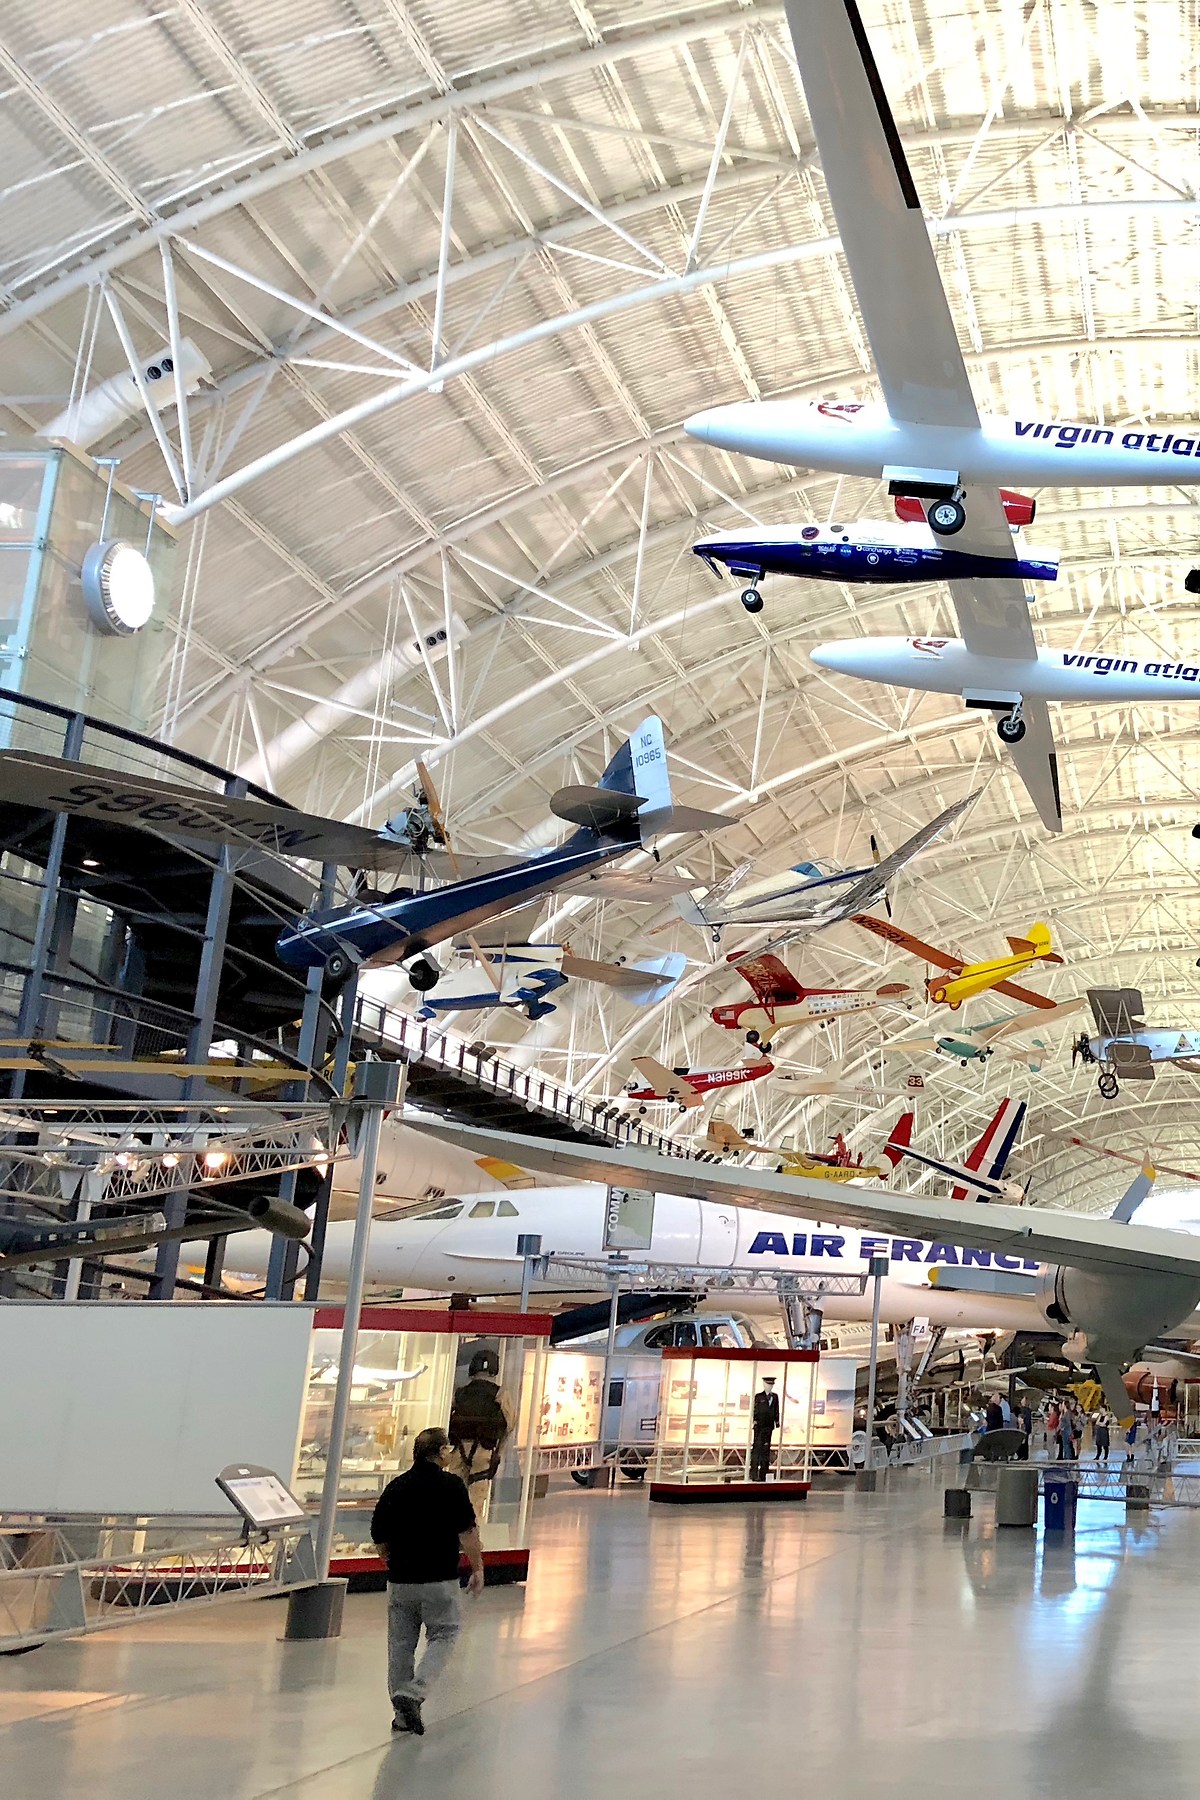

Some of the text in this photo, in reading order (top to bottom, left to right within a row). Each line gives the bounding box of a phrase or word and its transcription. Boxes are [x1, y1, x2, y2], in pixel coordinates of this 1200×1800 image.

[1014, 420, 1114, 449] virgin
[1063, 654, 1138, 676] virgin
[640, 733, 653, 748] NC
[635, 747, 661, 767] 10965
[909, 1076, 923, 1086] 33
[608, 1187, 625, 1232] COMM
[747, 1231, 845, 1258] AIR
[912, 1325, 926, 1335] FA
